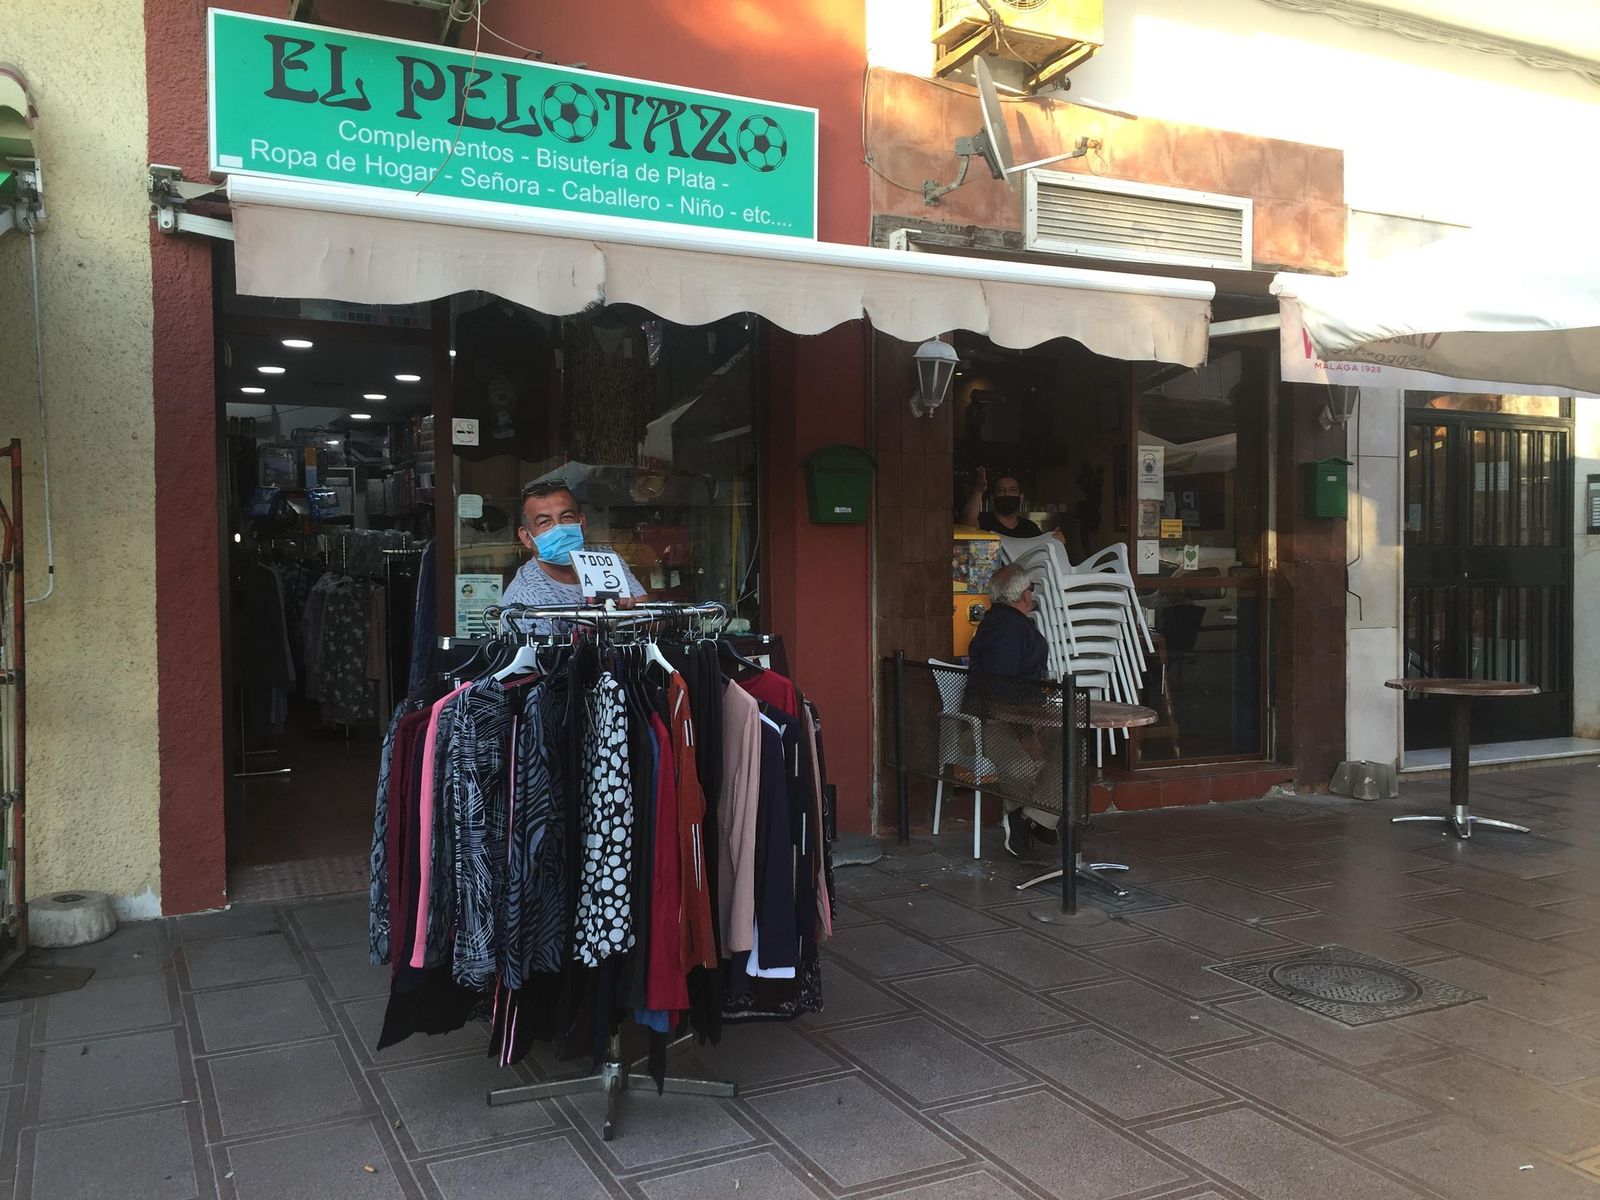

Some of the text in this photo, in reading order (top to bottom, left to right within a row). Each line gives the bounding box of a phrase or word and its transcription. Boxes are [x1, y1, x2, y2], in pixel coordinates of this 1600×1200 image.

[263, 34, 372, 111] EL
[250, 138, 318, 170] Ropa
[325, 149, 357, 173] de
[365, 153, 438, 186] Hogar
[460, 166, 540, 196] Señora
[562, 180, 661, 211] Caballero
[680, 195, 725, 219] Niño
[338, 119, 514, 164] Complementos
[538, 148, 628, 179] Bisutería
[635, 164, 660, 183] de
[667, 166, 716, 191] Plata
[579, 554, 613, 566] TODO
[584, 570, 621, 589] A 5
